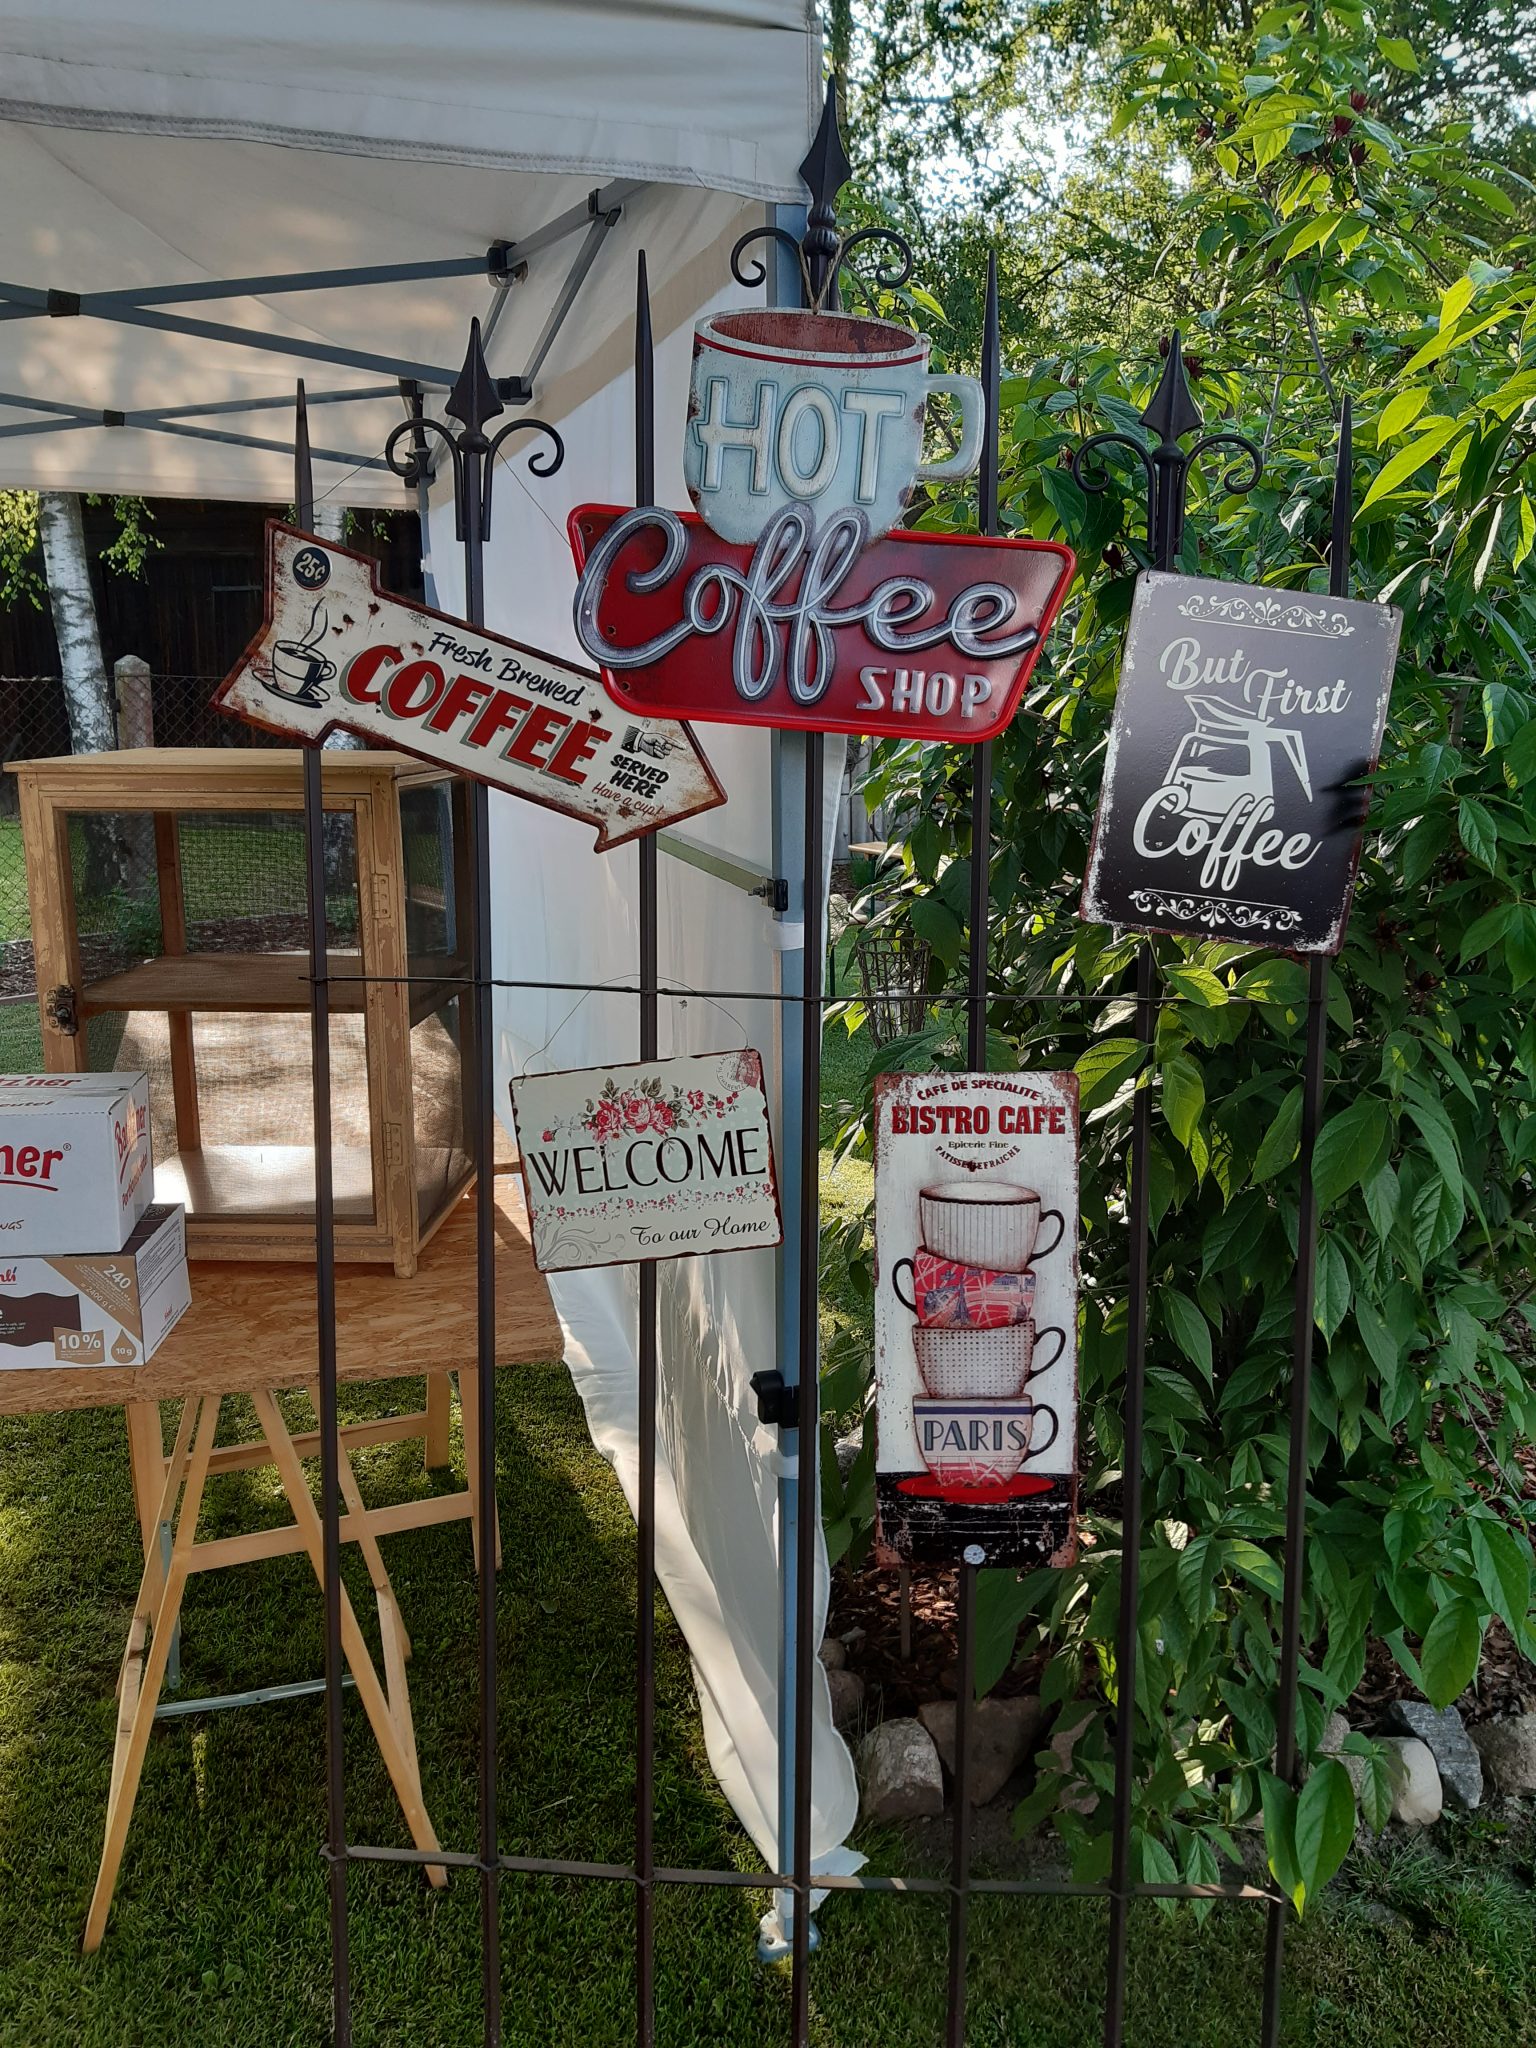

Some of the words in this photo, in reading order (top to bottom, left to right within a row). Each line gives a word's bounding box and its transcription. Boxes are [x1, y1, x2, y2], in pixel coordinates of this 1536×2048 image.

[693, 376, 906, 504] HOT
[573, 501, 1039, 706] Coffee
[428, 631, 493, 674] Fresh
[497, 656, 586, 707] Brewed
[1159, 636, 1250, 691] But
[1243, 667, 1353, 721] First
[339, 644, 613, 786] COFFEE
[856, 667, 992, 719] SHOP
[609, 770, 662, 799] HERE
[610, 754, 670, 783] SERVED
[591, 781, 622, 802] Have
[622, 796, 633, 807] a
[633, 800, 665, 817] cup!
[1132, 783, 1324, 892] Coffee
[916, 1082, 949, 1101] CAFE
[950, 1080, 969, 1091] DE
[970, 1079, 1041, 1101] SPECIALITE
[890, 1105, 991, 1135] BISTRO
[998, 1105, 1067, 1135] CAFE
[526, 1127, 767, 1198] WELCOME
[629, 1225, 664, 1246] To
[668, 1228, 702, 1243] our
[703, 1216, 771, 1237] Home
[103, 1264, 132, 1289] 240
[923, 1419, 1028, 1452] PARIS
